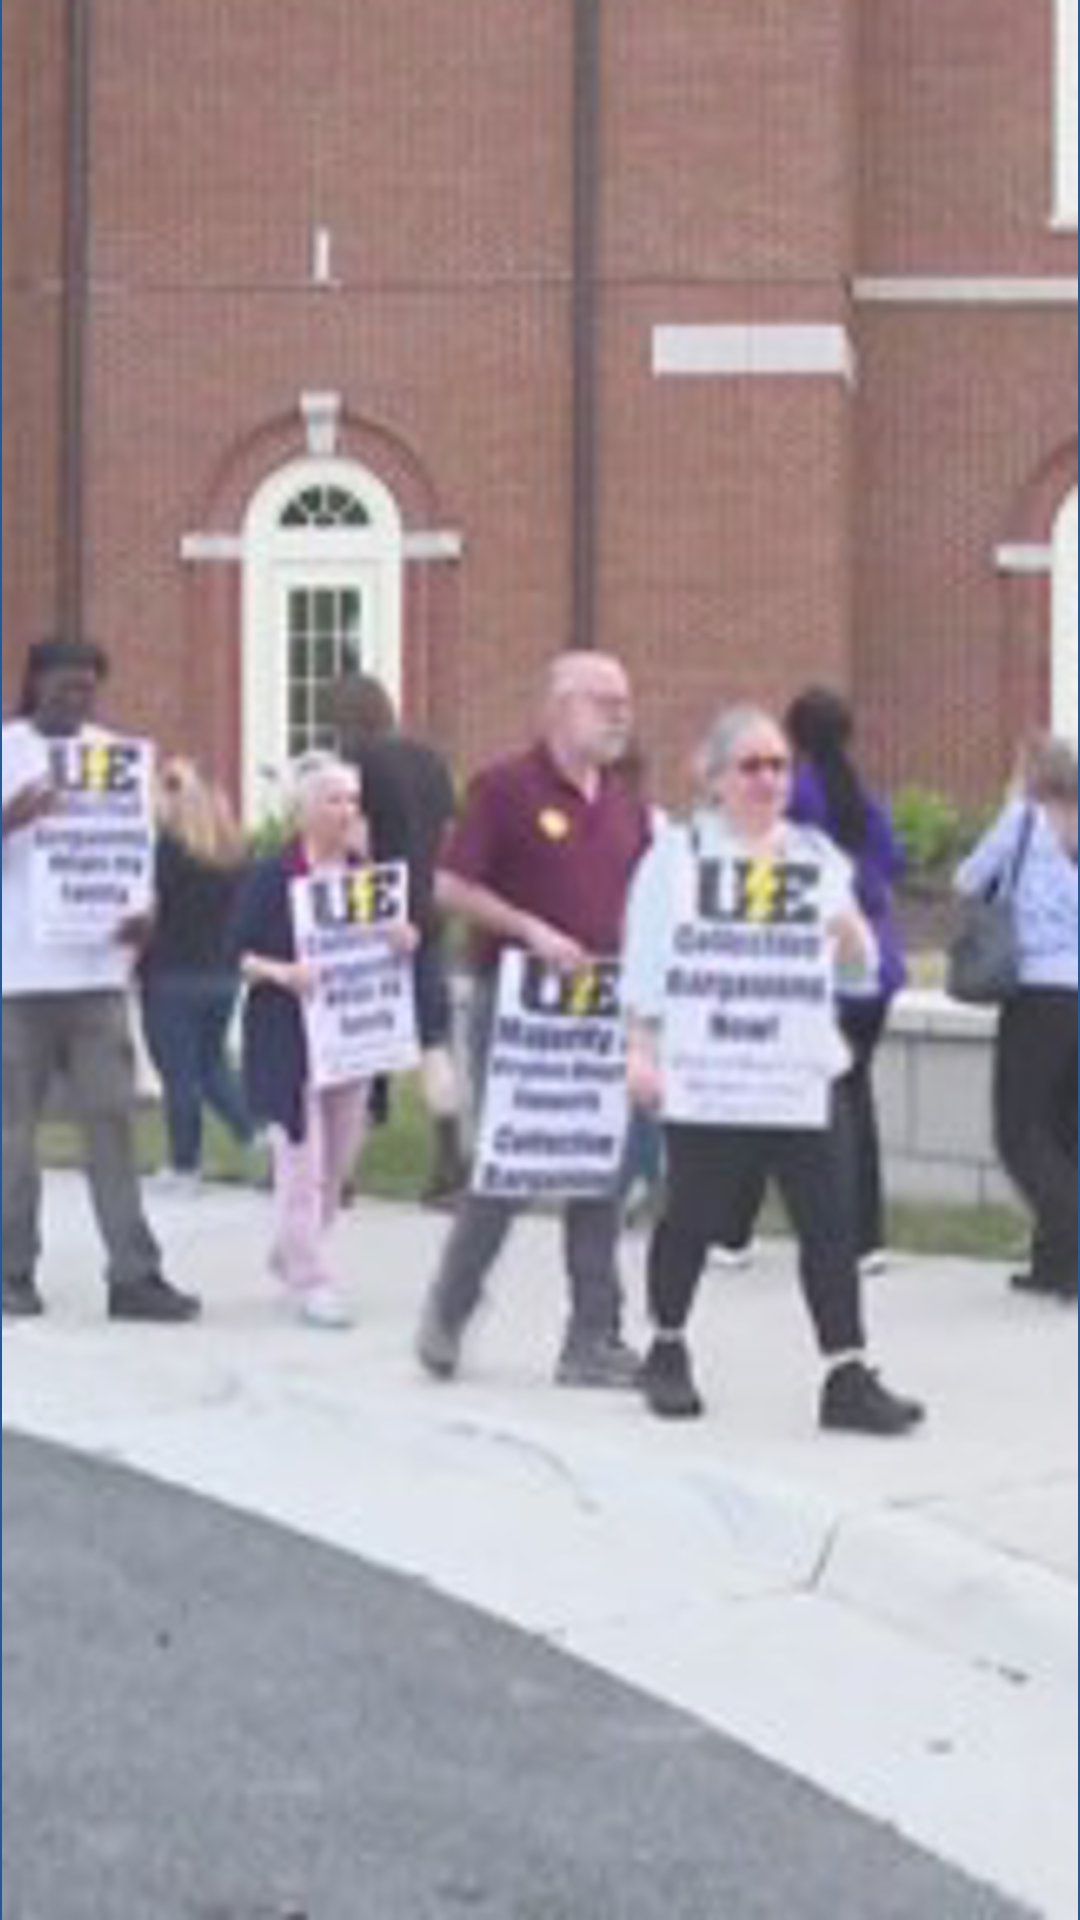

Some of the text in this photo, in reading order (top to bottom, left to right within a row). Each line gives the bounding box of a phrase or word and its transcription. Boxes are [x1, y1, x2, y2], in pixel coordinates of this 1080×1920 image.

[313, 867, 399, 928] UE
[697, 857, 819, 923] UE
[666, 966, 827, 1003] Bargaining
